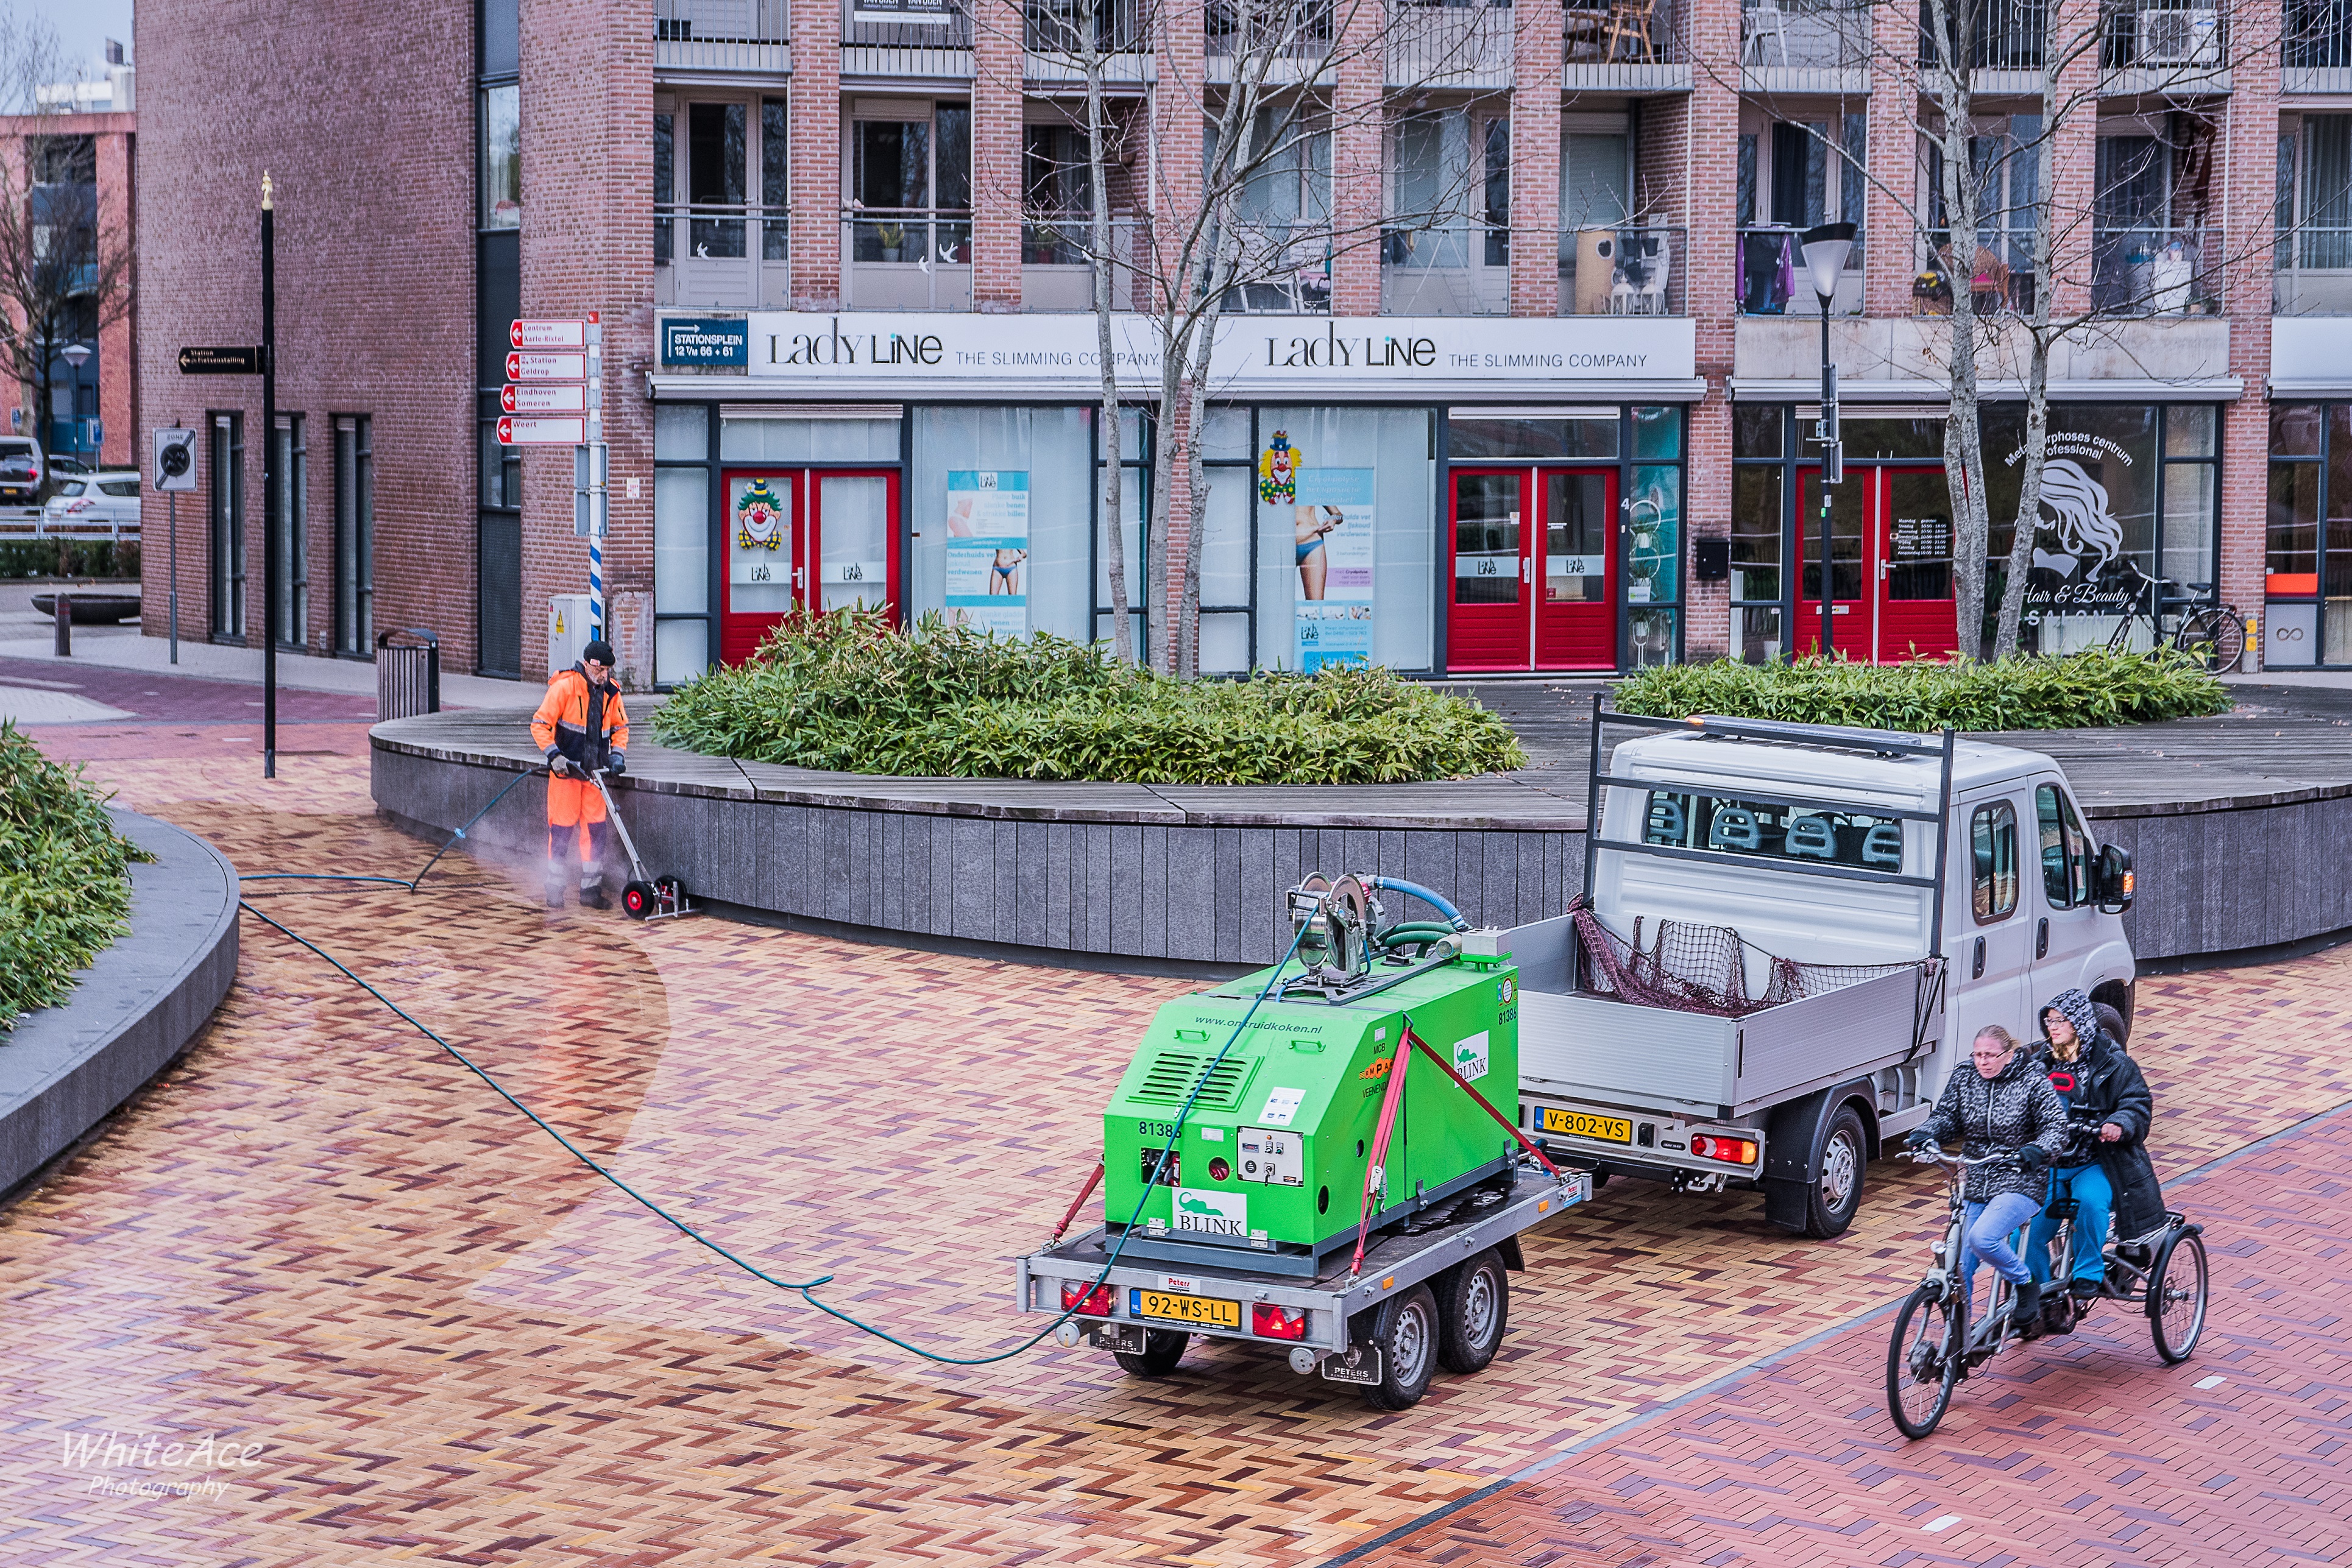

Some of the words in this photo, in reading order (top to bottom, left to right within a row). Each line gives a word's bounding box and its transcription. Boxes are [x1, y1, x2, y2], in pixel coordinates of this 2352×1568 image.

[675, 334, 743, 345] STATIONSPLEIN
[766, 316, 865, 364] Lady
[956, 351, 986, 365] THE
[993, 351, 1072, 365] SLIMMING
[1264, 320, 1361, 367] Lady
[1449, 354, 1478, 367] THE
[1485, 354, 1562, 367] SLIMMING
[1569, 354, 1647, 367] COMPANY
[675, 346, 685, 356] 12
[701, 346, 712, 356] 66
[723, 346, 733, 356] 61
[2092, 436, 2133, 467] centrum
[1621, 498, 1630, 510] 4
[2023, 583, 2052, 604] Hair
[2054, 584, 2071, 604] &
[2073, 583, 2131, 609] Beauty
[2028, 610, 2105, 626] SALON
[1499, 1006, 1517, 1025] 81386
[1374, 1043, 1386, 1054] MCB
[1457, 1057, 1487, 1079] BLINK
[1362, 1082, 1387, 1098] VEENEND
[1549, 1112, 1624, 1138] V-802-VS
[1180, 1215, 1242, 1237] BLINK
[1169, 1277, 1189, 1287] Peters
[1149, 1296, 1231, 1323] 92-WS-LL
[1099, 1337, 1133, 1347] PETERS
[1334, 1367, 1369, 1377] PETERS
